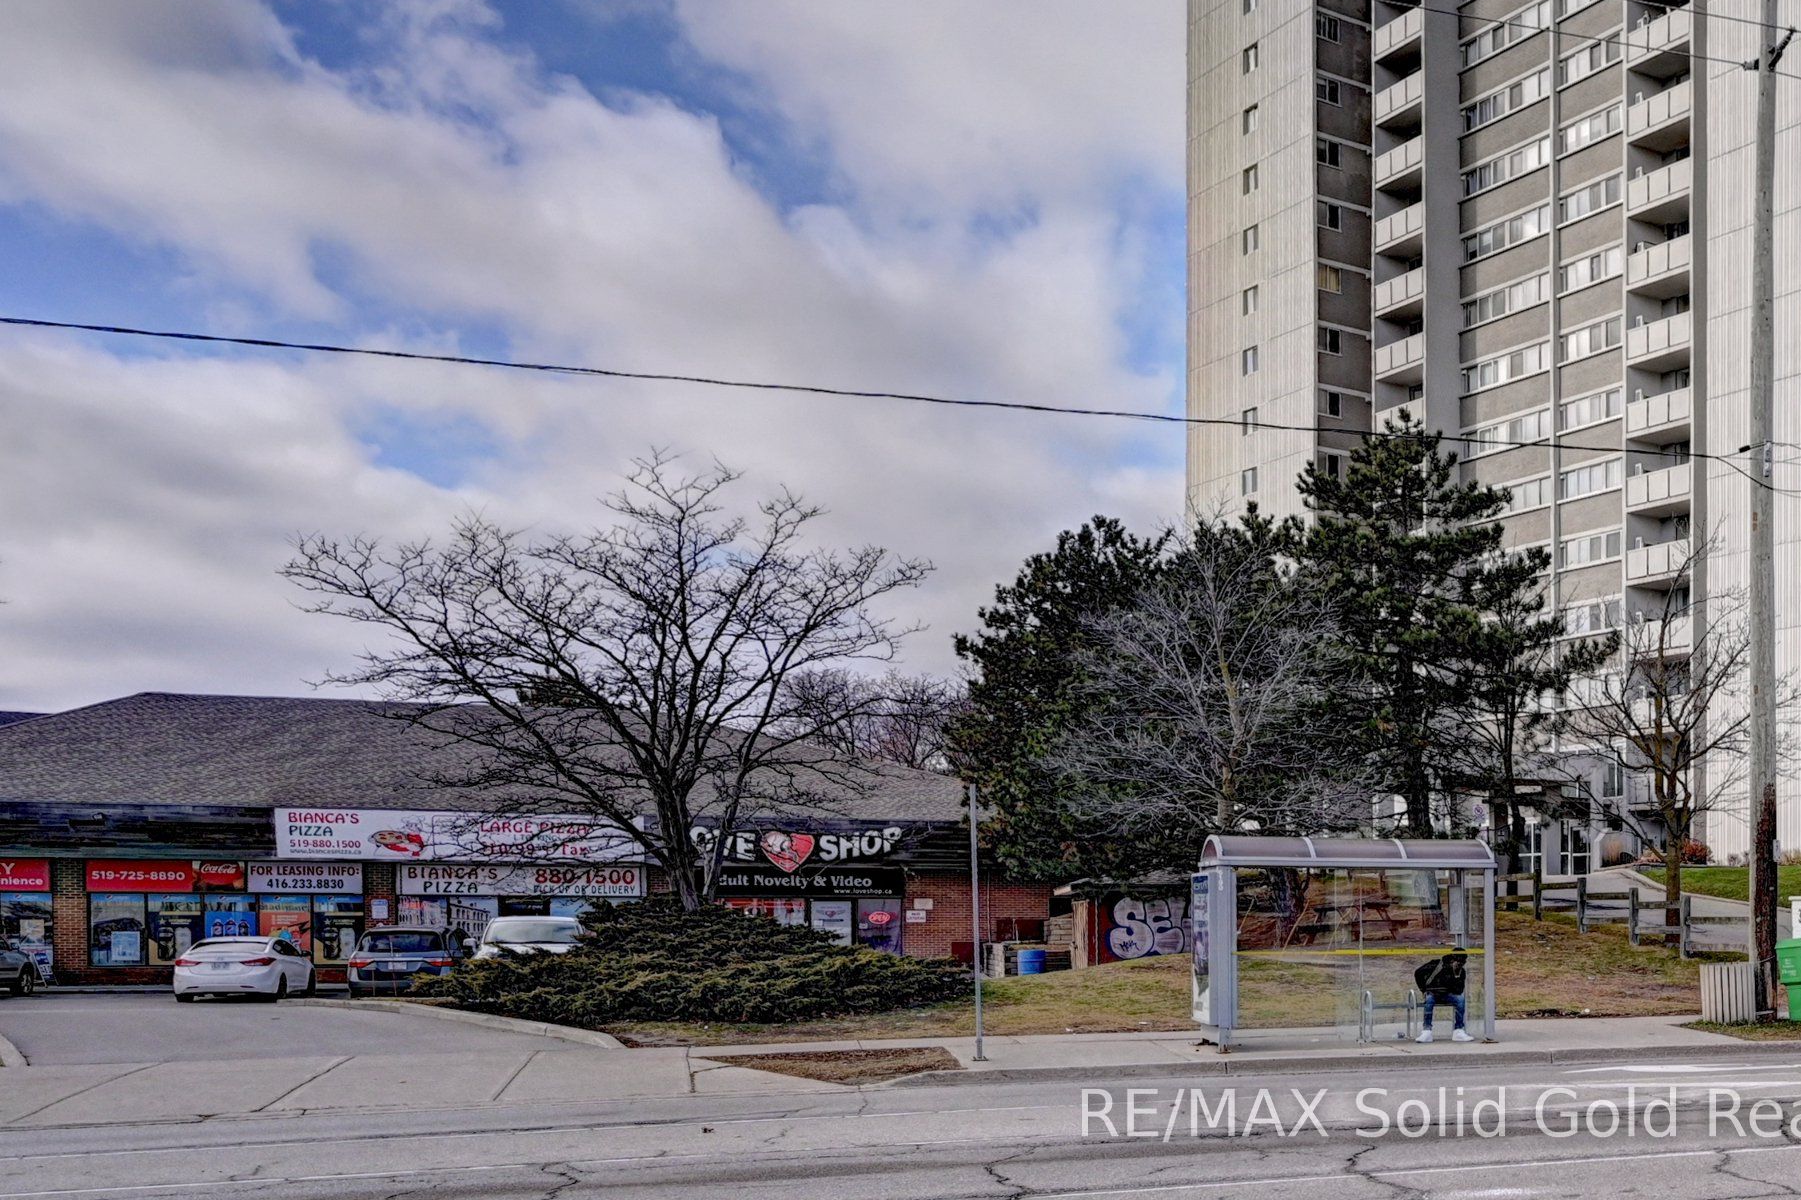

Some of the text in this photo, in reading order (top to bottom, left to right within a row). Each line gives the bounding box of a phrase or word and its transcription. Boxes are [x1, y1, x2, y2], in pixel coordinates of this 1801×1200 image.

[288, 812, 360, 824] BIANCA'S
[289, 826, 334, 837] PIZZA
[480, 821, 532, 833] LARGE
[819, 826, 901, 862] SHOP
[0, 862, 16, 875] Y
[250, 865, 360, 876] FOR LEASING INFO:
[408, 866, 498, 880] BIANCA'S
[91, 870, 186, 881] 519-725-8890
[719, 874, 873, 889] dult Novelty & Video
[266, 878, 344, 889] 416.233.8830
[423, 881, 478, 893] PIZZA
[591, 886, 636, 895] DELIVERY
